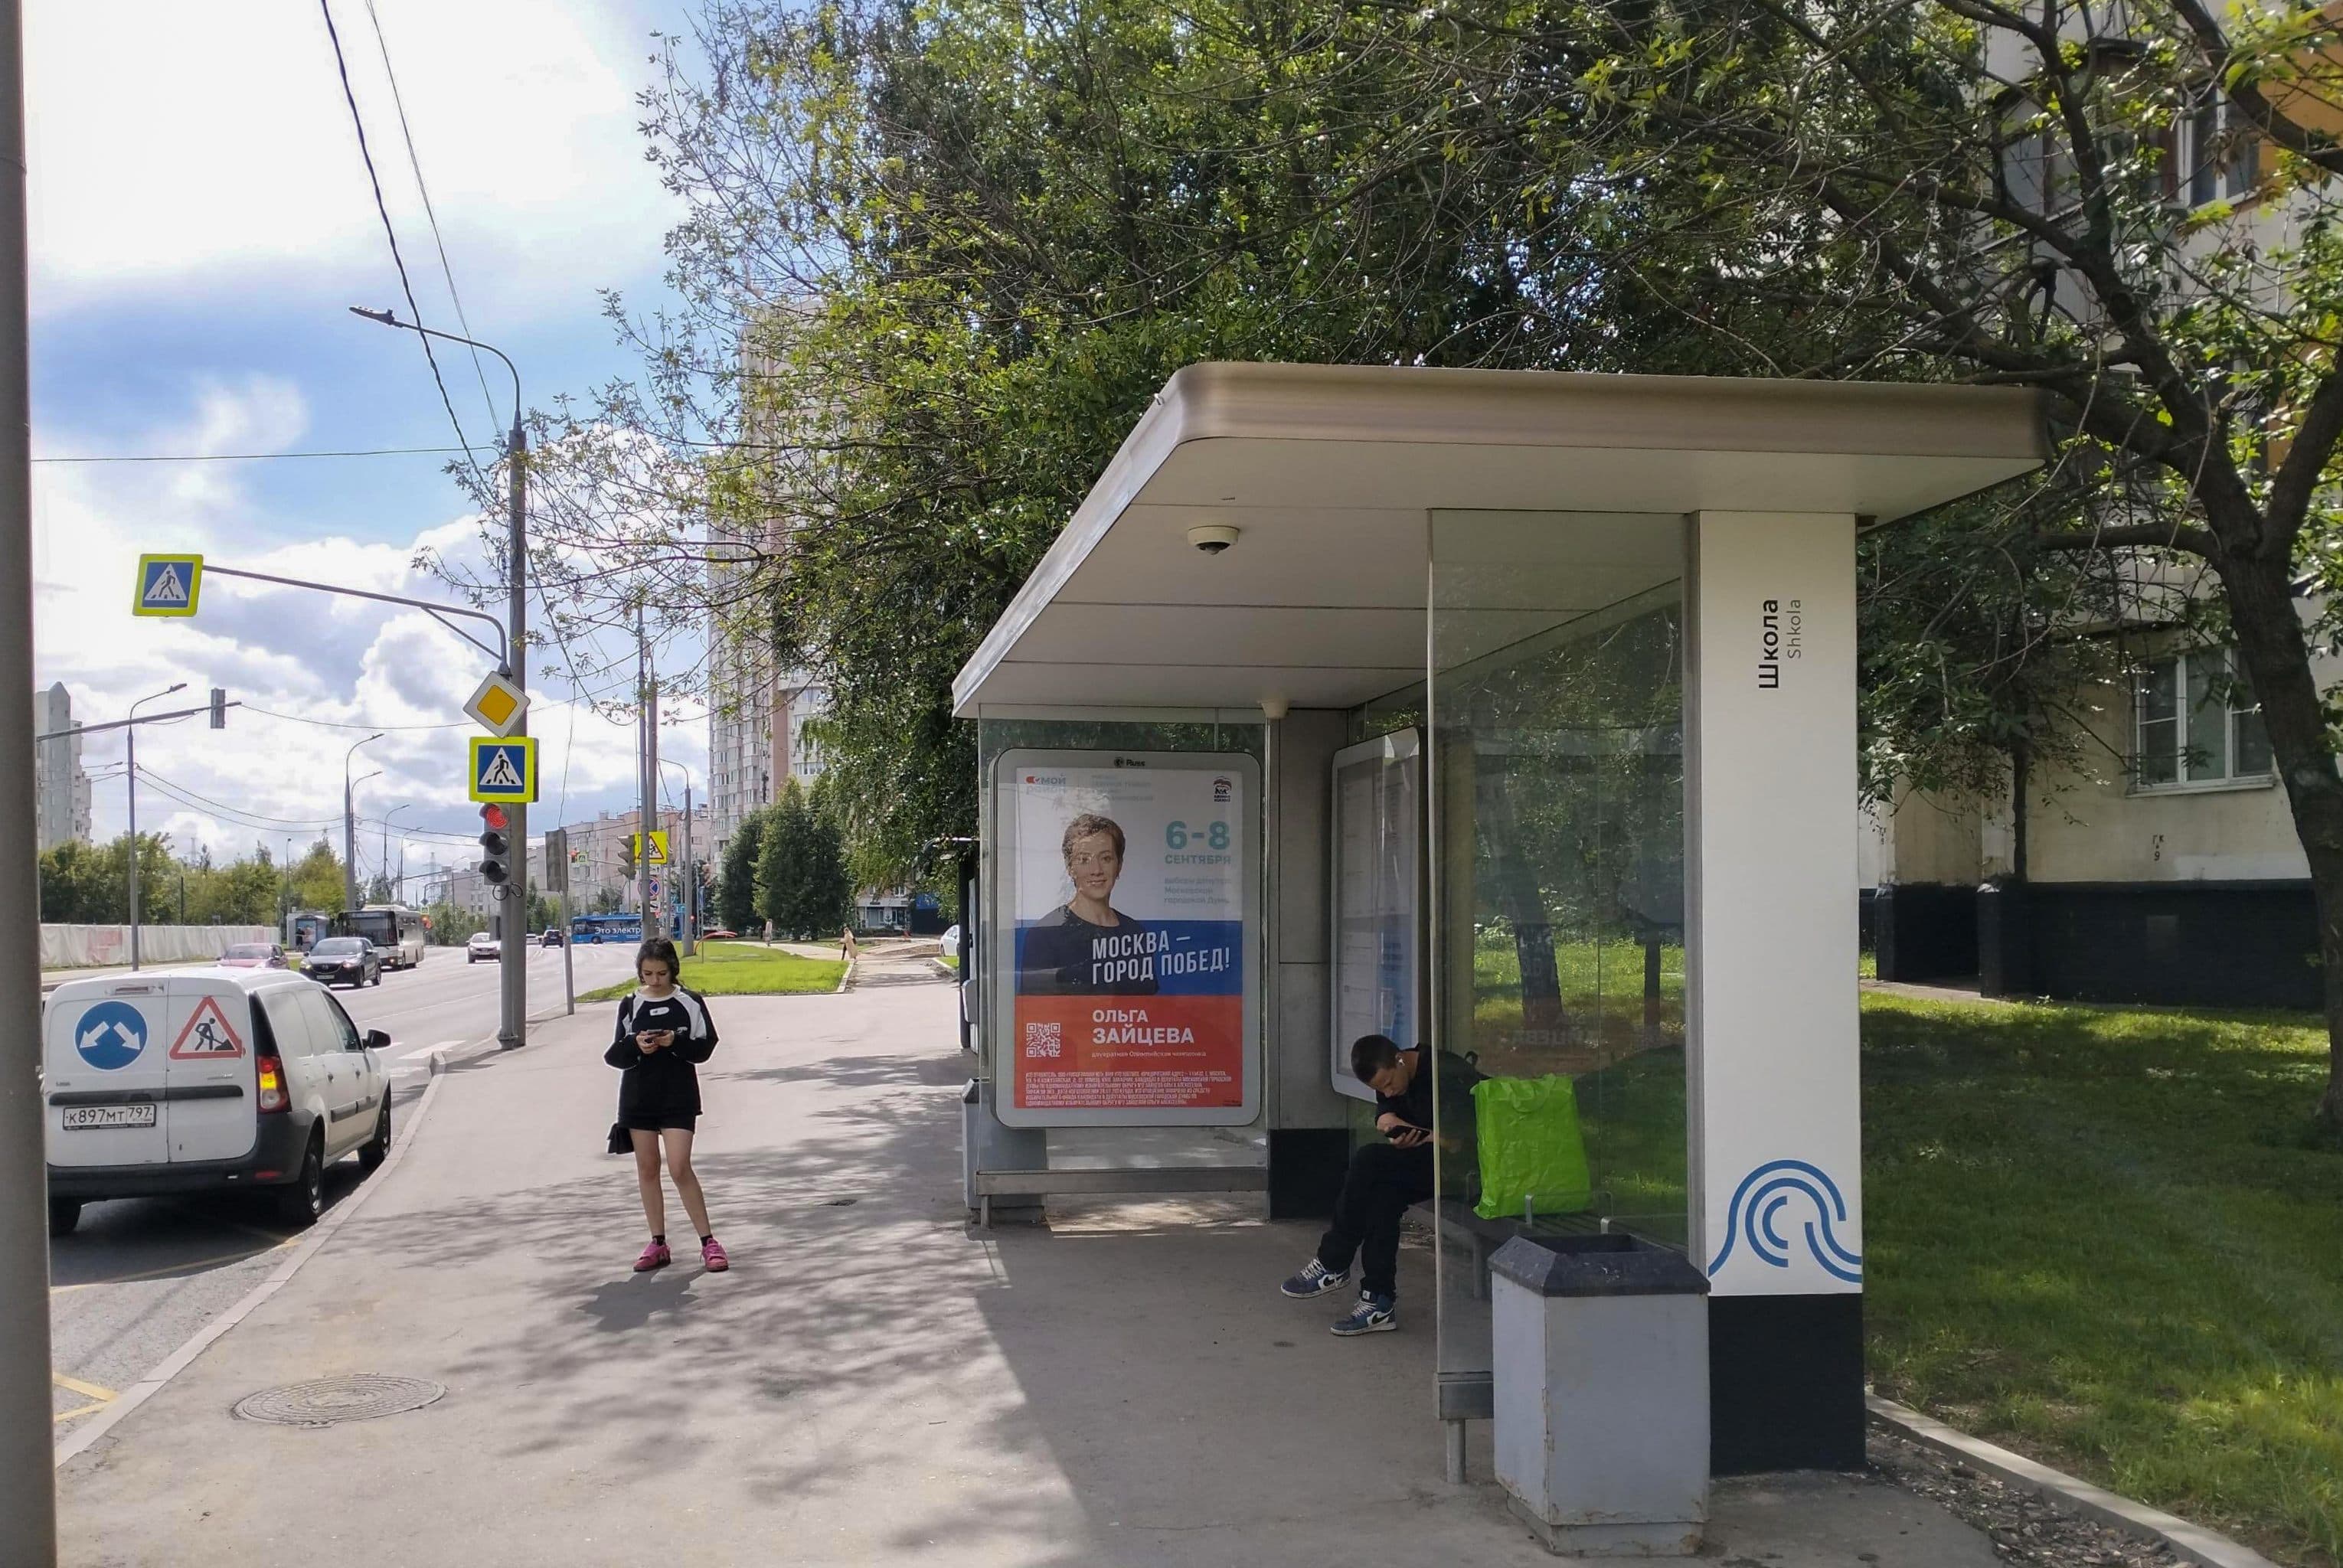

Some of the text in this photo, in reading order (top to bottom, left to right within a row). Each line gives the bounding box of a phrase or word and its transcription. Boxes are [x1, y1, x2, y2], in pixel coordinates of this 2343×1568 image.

[1786, 599, 1801, 658] Shkola
[1759, 599, 1779, 688] Школа
[1165, 855, 1231, 864] СЕНТЯБРЯ
[1092, 930, 1170, 960] МОСКВА
[1092, 947, 1230, 985] ГОРОД ПОБЕД!
[1092, 1010, 1149, 1023] ОЛЬГА
[1093, 1024, 1194, 1046] ЗАЙЦЕВА
[129, 1107, 150, 1118] 797
